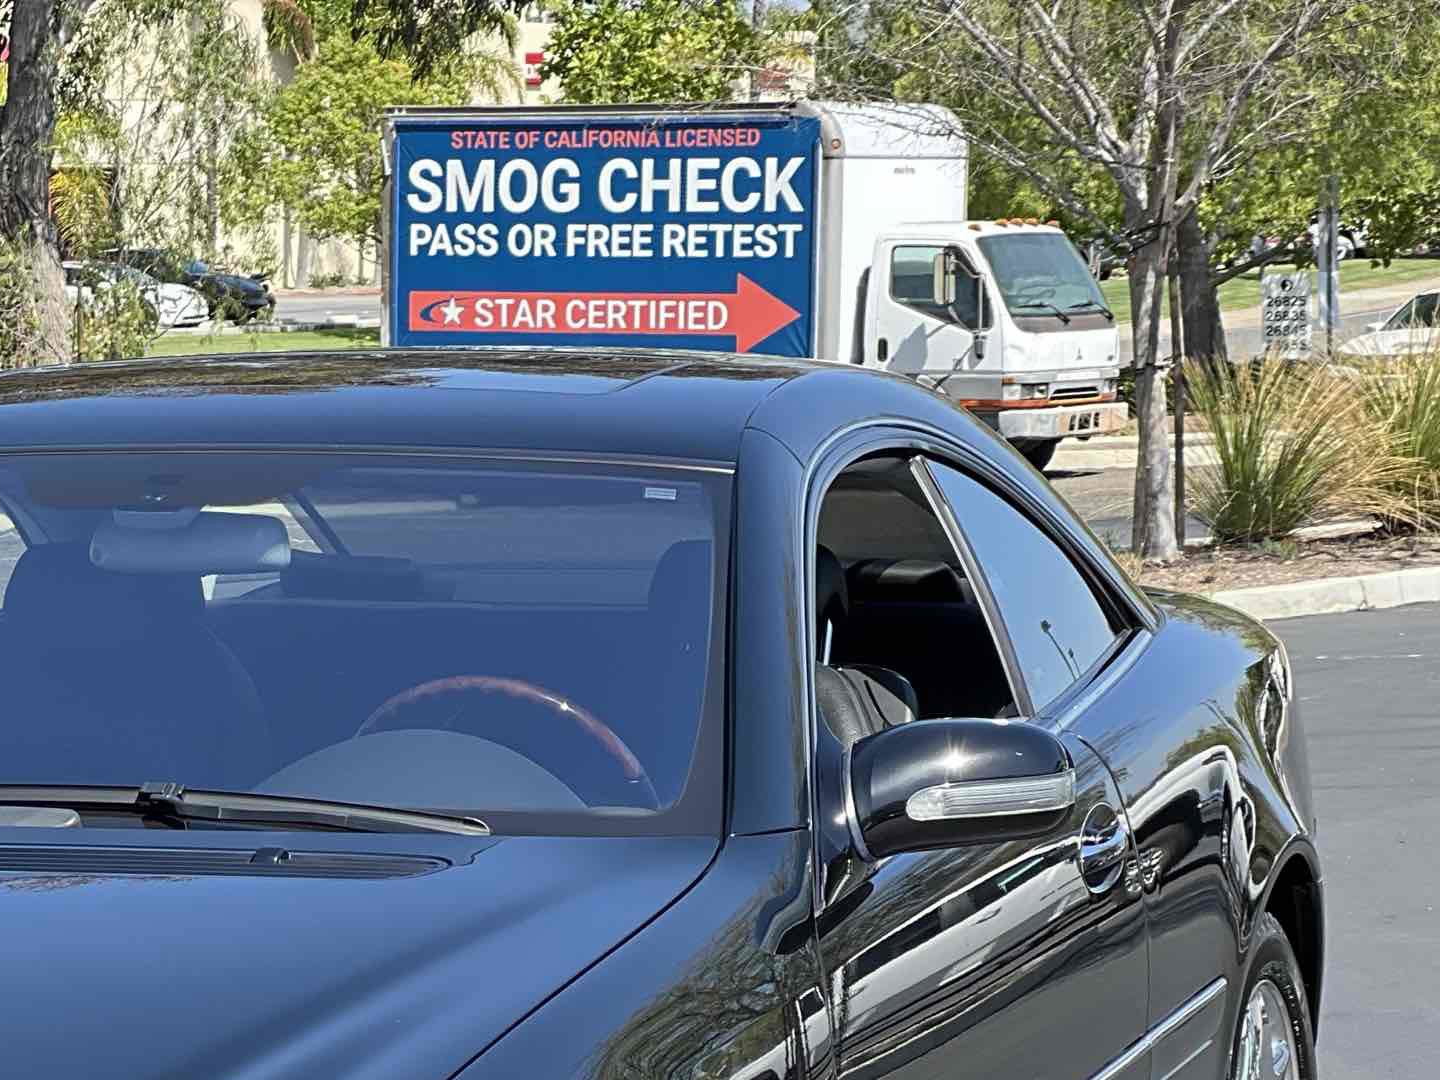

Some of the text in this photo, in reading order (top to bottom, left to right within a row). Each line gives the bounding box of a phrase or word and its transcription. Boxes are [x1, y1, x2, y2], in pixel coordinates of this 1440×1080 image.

[451, 128, 760, 149] STATE OF CALIFORNIA LICENSED
[406, 157, 805, 213] SMOG CHECK
[409, 223, 802, 257] PASS OR FREE RETEST
[474, 299, 728, 331] STAR CERTIFIED
[1266, 296, 1306, 307] 26825
